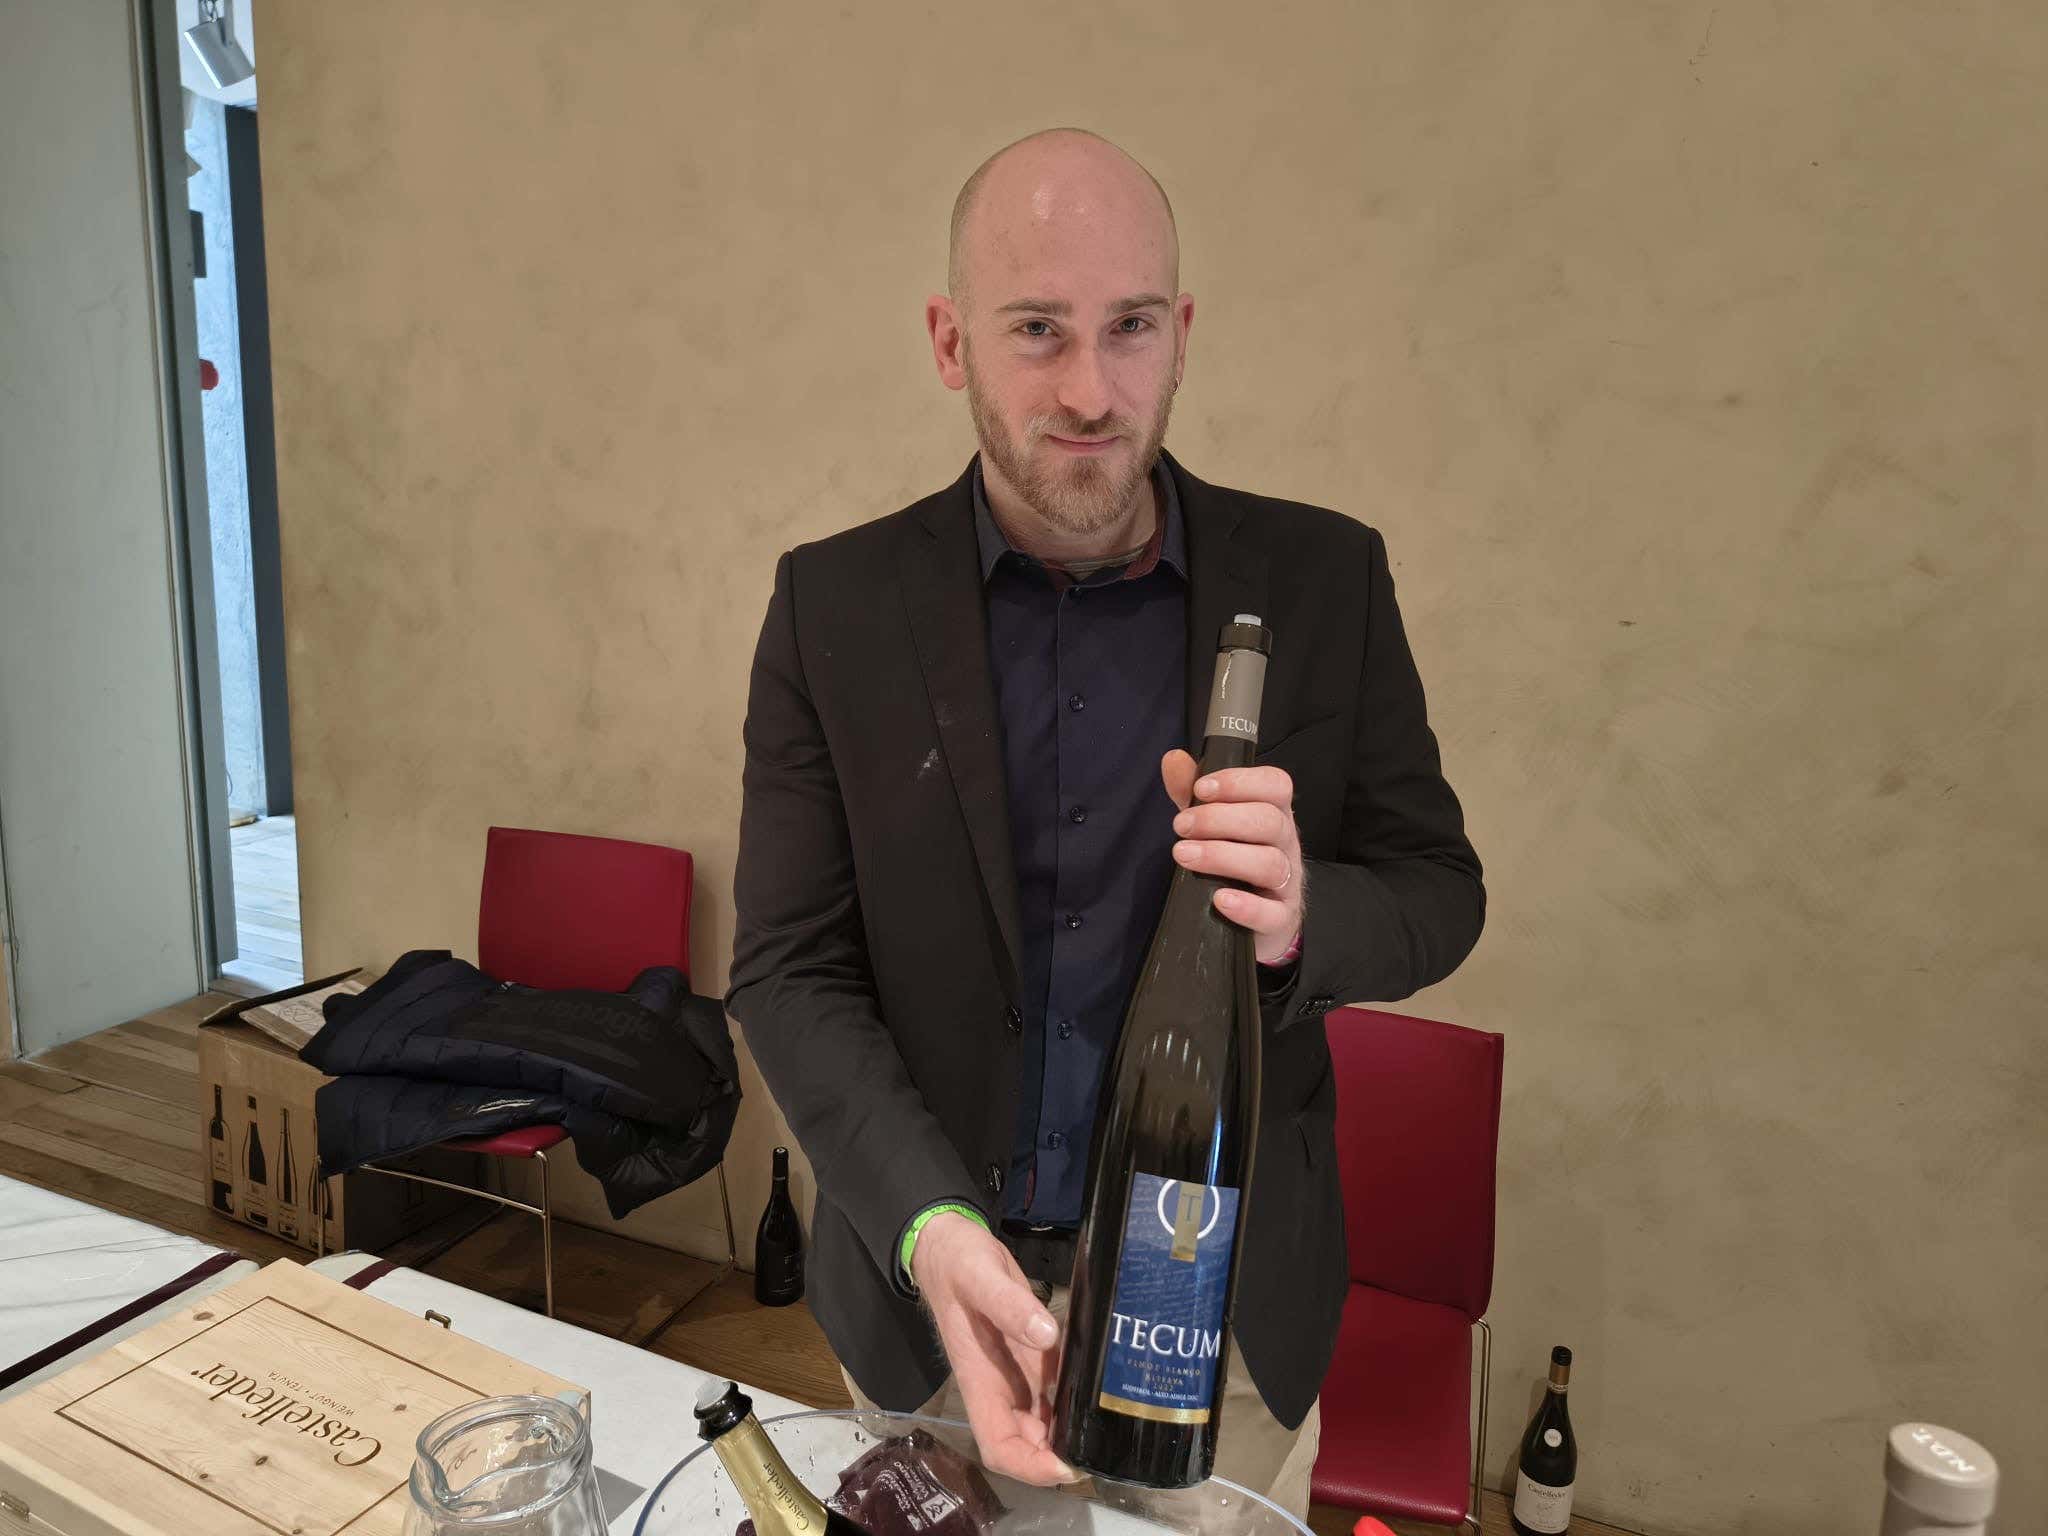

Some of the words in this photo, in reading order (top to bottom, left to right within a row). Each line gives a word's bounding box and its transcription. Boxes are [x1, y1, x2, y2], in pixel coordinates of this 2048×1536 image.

[1112, 1312, 1221, 1358] TECUM
[267, 1369, 301, 1392] TENUTA
[190, 1362, 382, 1467] Castelfeder
[307, 1391, 357, 1417] WEINGUT
[762, 1462, 810, 1531] Castelfeder
